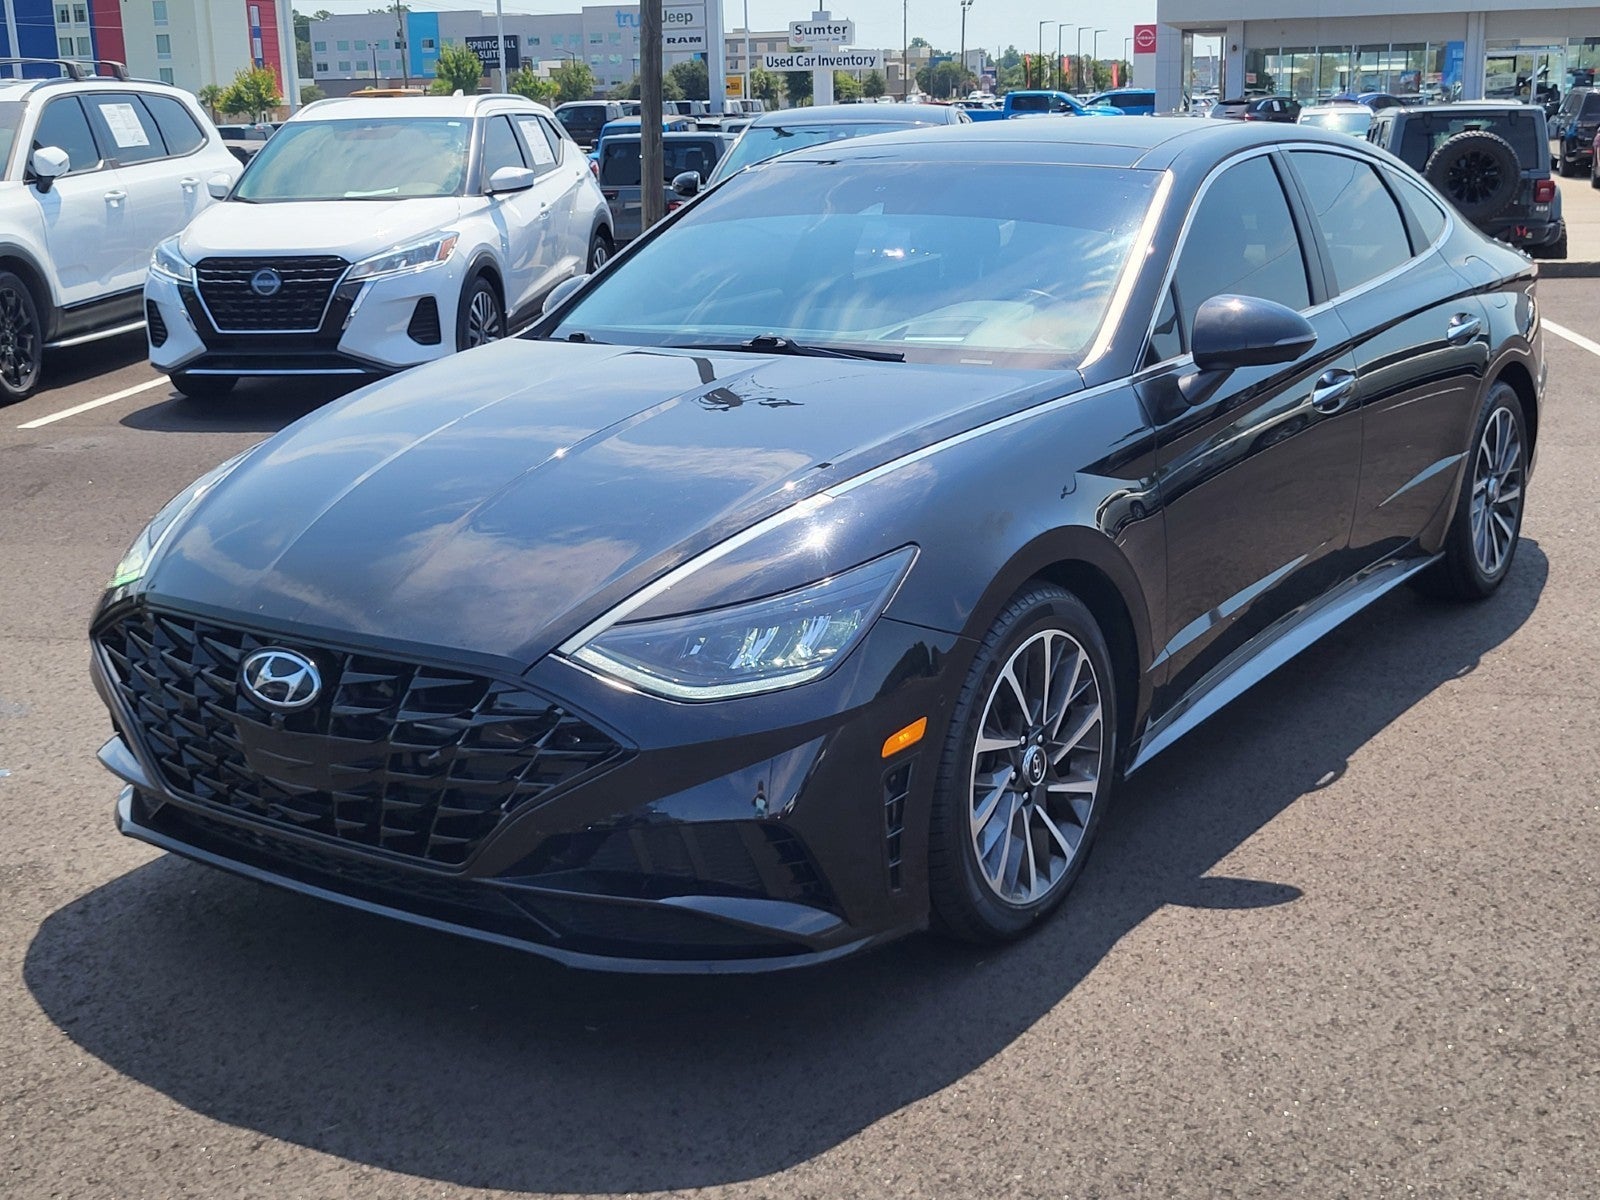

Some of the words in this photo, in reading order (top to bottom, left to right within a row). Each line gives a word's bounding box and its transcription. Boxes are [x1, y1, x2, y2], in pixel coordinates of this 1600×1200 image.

[615, 10, 641, 27] tru
[661, 10, 693, 25] Jeep
[795, 24, 848, 36] Sumter
[466, 39, 516, 50] SPRINGILL
[666, 36, 702, 44] RAM
[479, 50, 505, 59] SUITE
[766, 56, 793, 68] Used
[796, 55, 815, 67] Car
[818, 55, 876, 67] Inventory
